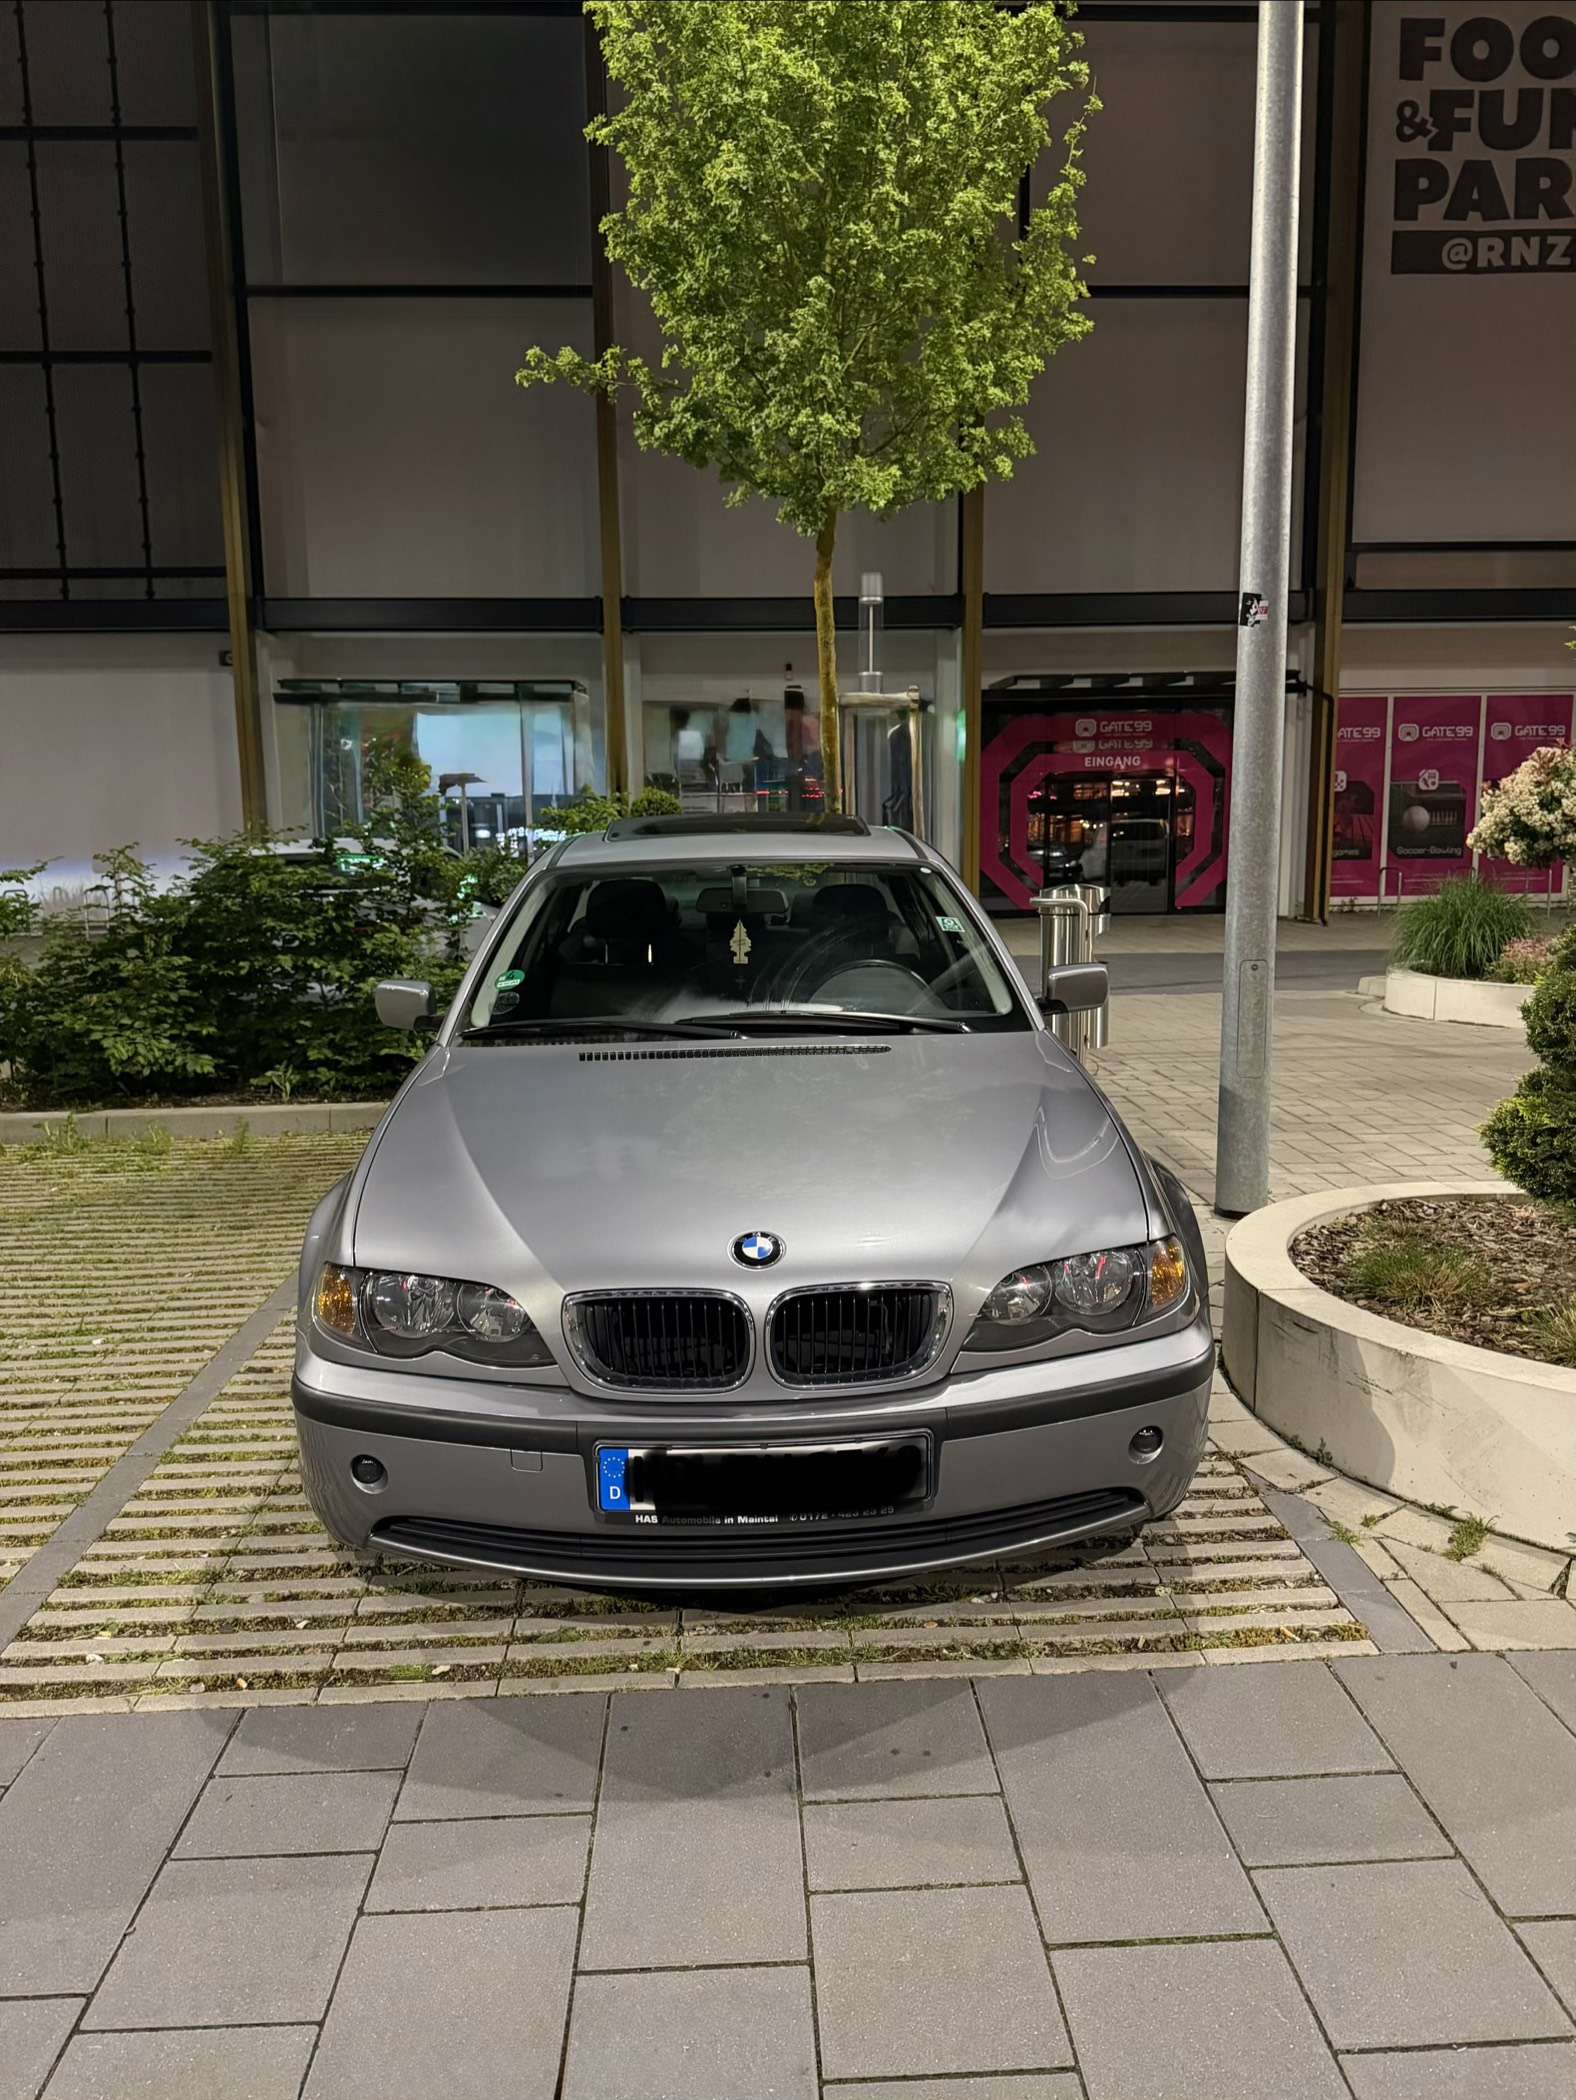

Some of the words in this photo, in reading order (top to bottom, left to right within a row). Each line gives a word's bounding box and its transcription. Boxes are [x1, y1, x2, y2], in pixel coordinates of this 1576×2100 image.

[1400, 16, 1576, 82] FOO
[1394, 157, 1575, 221] PAR
[1442, 236, 1571, 269] @RNZ
[1337, 727, 1381, 738] ATE99
[1084, 755, 1141, 768] EINGANG
[610, 1486, 621, 1499] D
[635, 1514, 658, 1524] HAS
[724, 1515, 734, 1524] in
